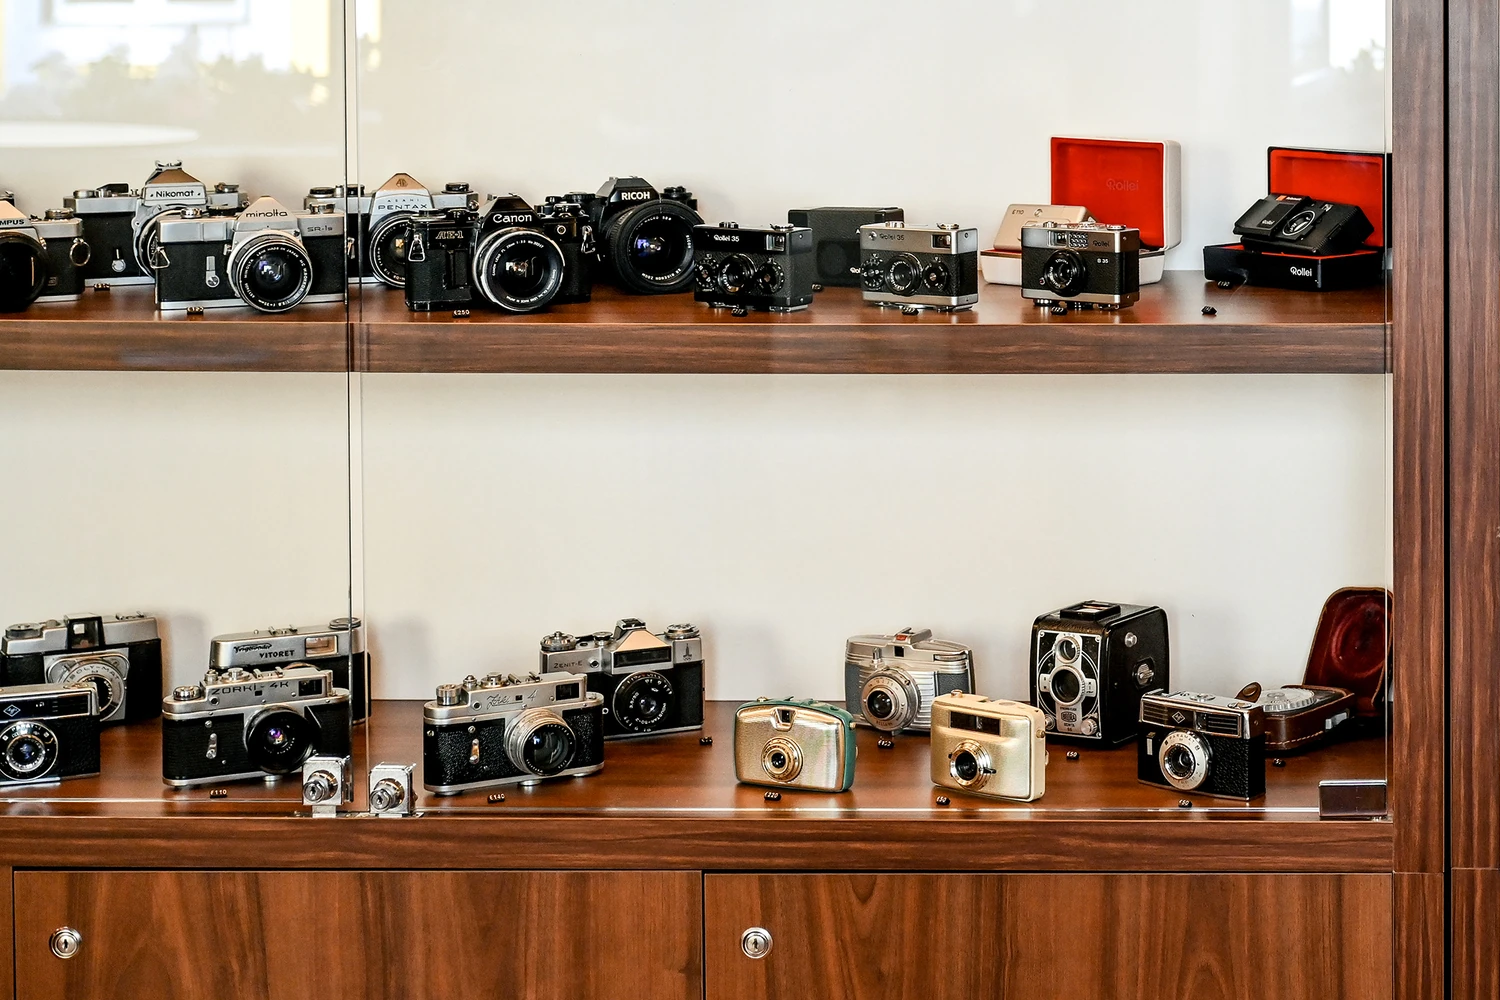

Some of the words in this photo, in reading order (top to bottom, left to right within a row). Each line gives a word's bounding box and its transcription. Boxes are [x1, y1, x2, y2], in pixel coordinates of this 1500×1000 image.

[1106, 178, 1140, 192] Rollei
[155, 188, 194, 198] Nikomat
[621, 191, 650, 201] RICOH
[246, 208, 288, 218] minolta
[492, 213, 533, 224] Canon
[435, 230, 464, 240] AE-1
[714, 234, 730, 242] Rollei
[878, 233, 896, 242] Rollei
[1092, 239, 1111, 248] Rollei
[1290, 266, 1313, 278] Rollei
[453, 308, 470, 316] €250
[260, 650, 296, 660] VITORET
[554, 660, 584, 670] ZENIT-E
